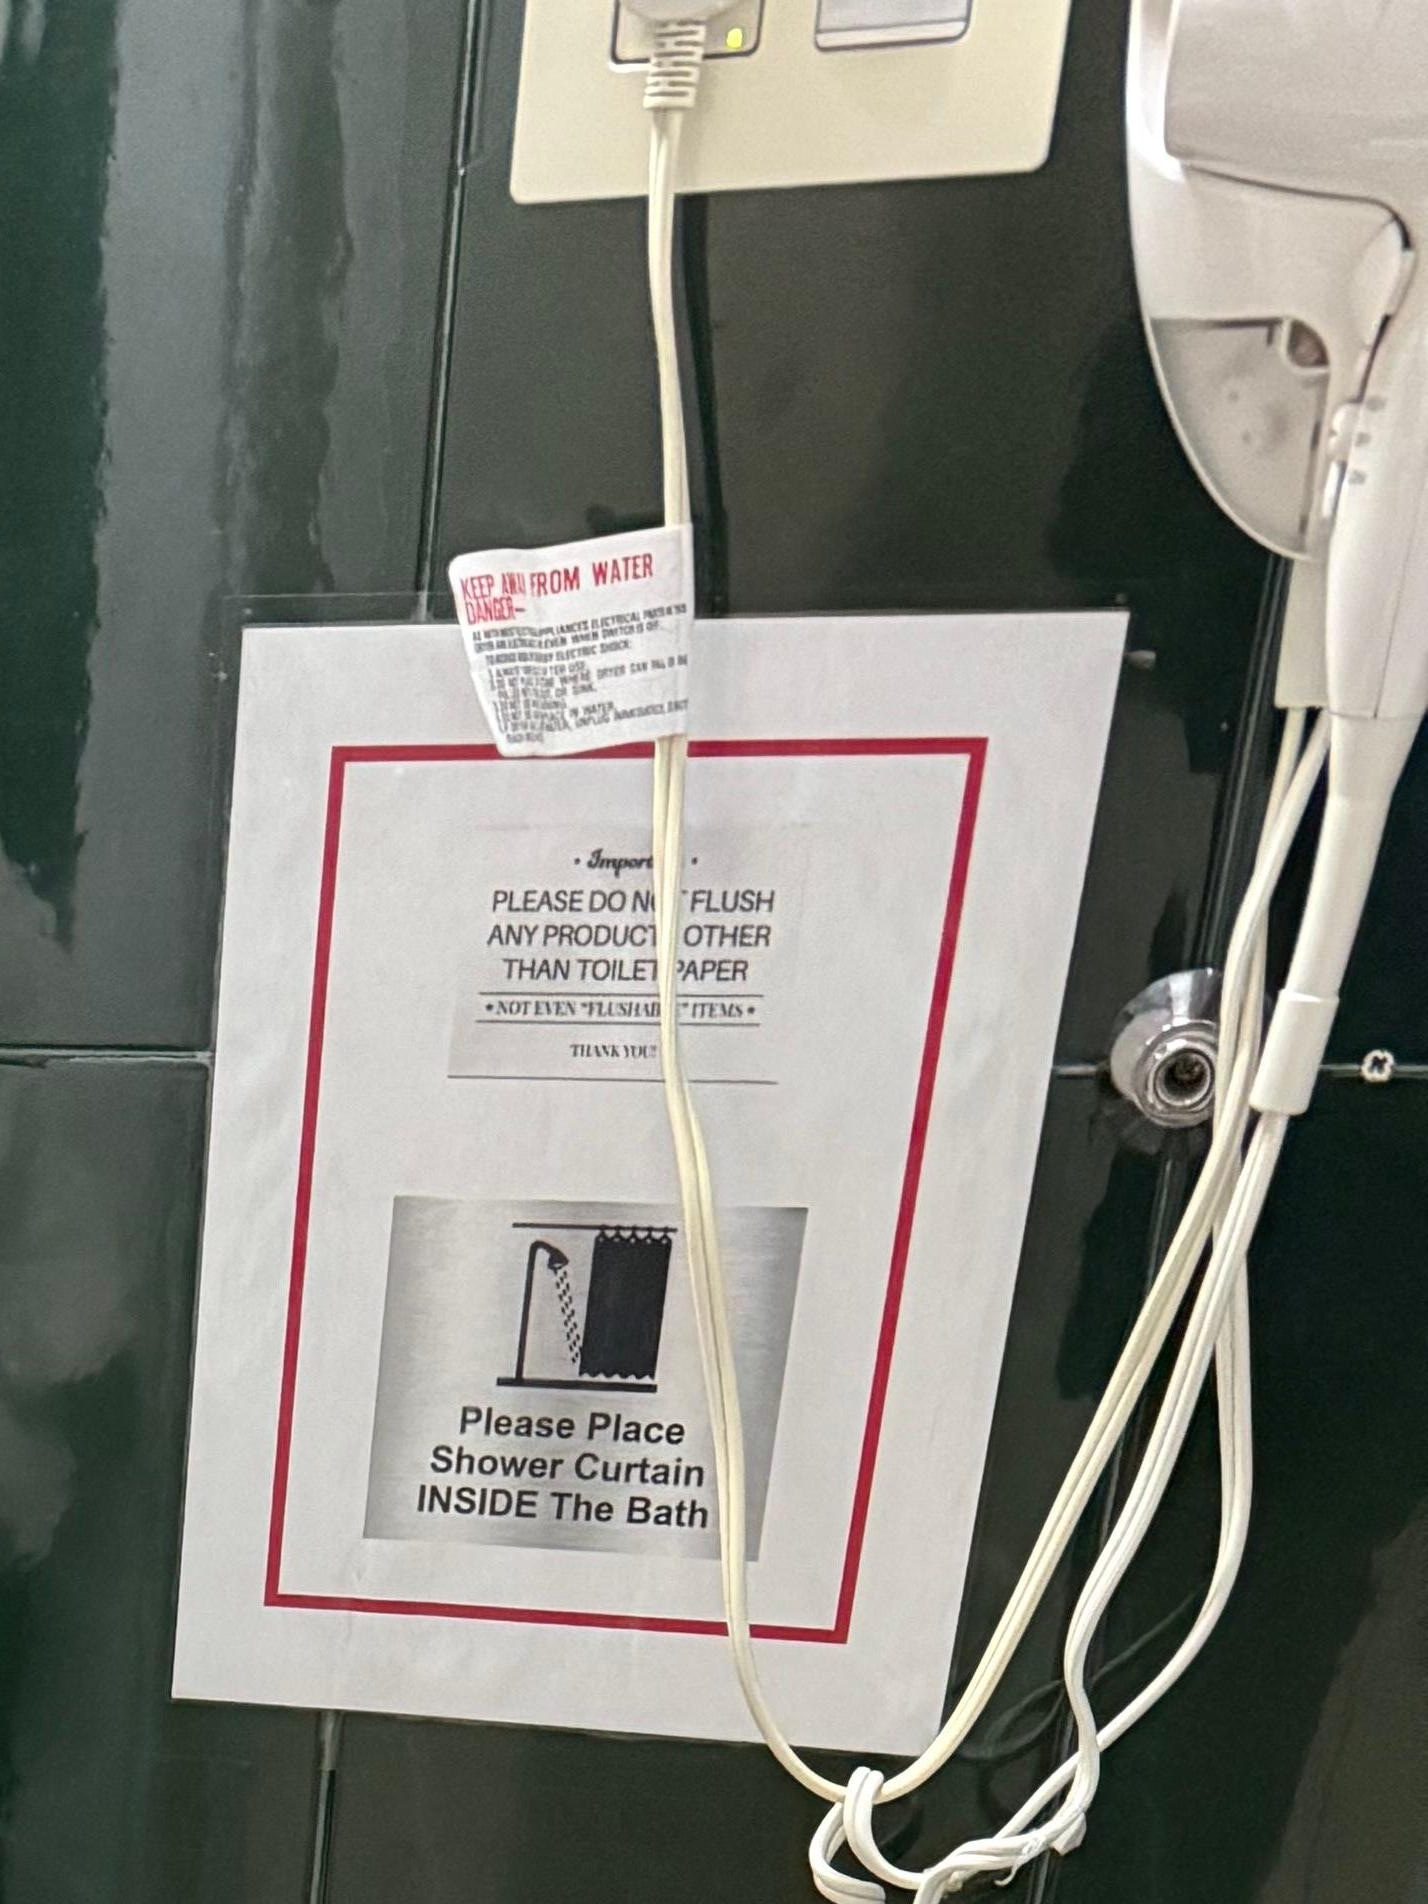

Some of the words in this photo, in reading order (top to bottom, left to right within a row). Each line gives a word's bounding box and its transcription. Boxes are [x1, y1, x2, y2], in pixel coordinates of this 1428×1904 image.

[460, 574, 494, 600] KEEP
[531, 566, 580, 598] FROM
[592, 553, 653, 587] WATER
[586, 848, 654, 877] Import
[492, 889, 584, 912] PLEASE
[589, 889, 627, 913] DO
[690, 890, 775, 913] FLUSH
[486, 924, 539, 947] ANY
[543, 924, 658, 947] PRODUCT
[683, 924, 772, 947] OTHER
[503, 958, 571, 981] THAN
[577, 958, 659, 981] TOILET
[496, 1000, 529, 1017] NOT
[534, 1000, 576, 1017] EVEN
[692, 1003, 744, 1018] ITEMS
[570, 1044, 620, 1058] THANK
[459, 1406, 575, 1439] Please
[587, 1412, 685, 1445] Place
[430, 1444, 564, 1479] Shower
[574, 1452, 704, 1487] Curtain
[416, 1484, 539, 1518] INSIDE
[550, 1491, 614, 1522] The
[626, 1496, 709, 1528] Bath
